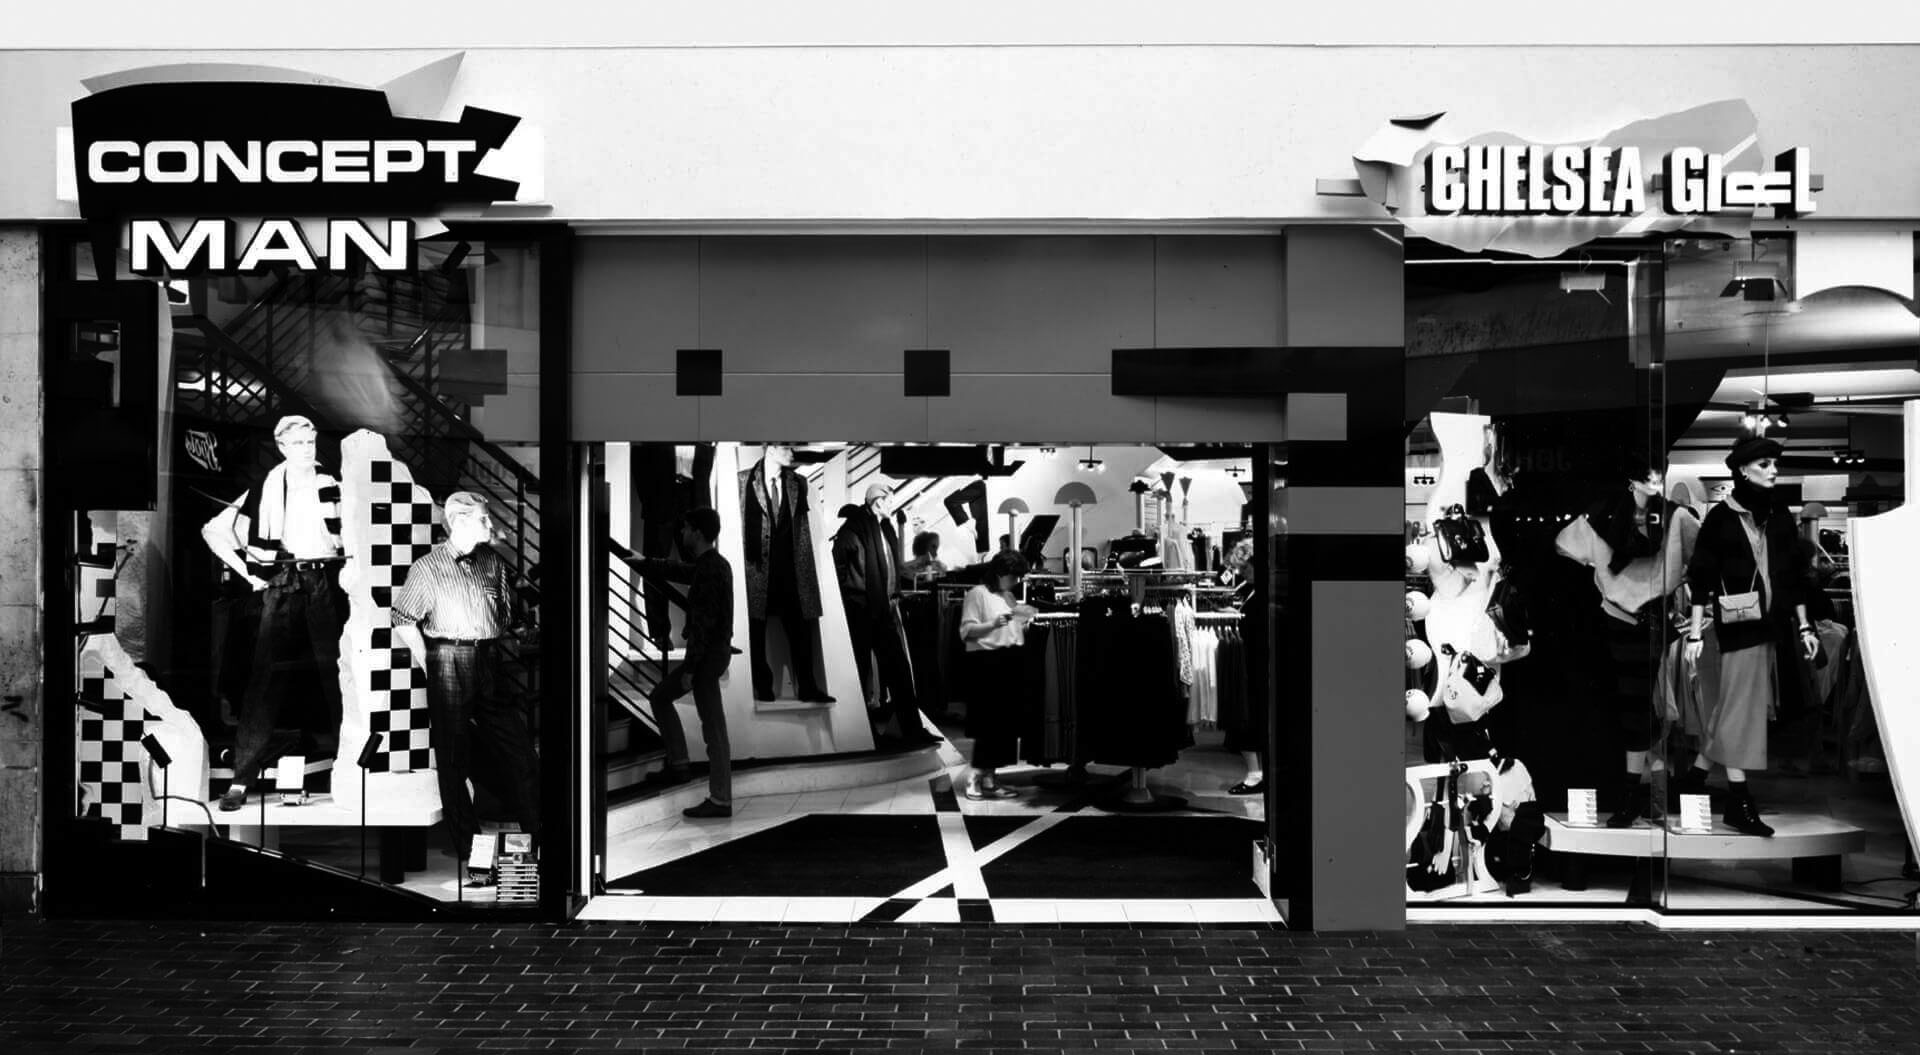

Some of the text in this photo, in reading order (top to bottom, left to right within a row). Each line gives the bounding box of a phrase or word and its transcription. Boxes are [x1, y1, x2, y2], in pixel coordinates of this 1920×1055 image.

[88, 140, 477, 183] CONCEPT
[1431, 144, 1817, 213] CHELSEA GIRL
[131, 219, 408, 271] MAN
